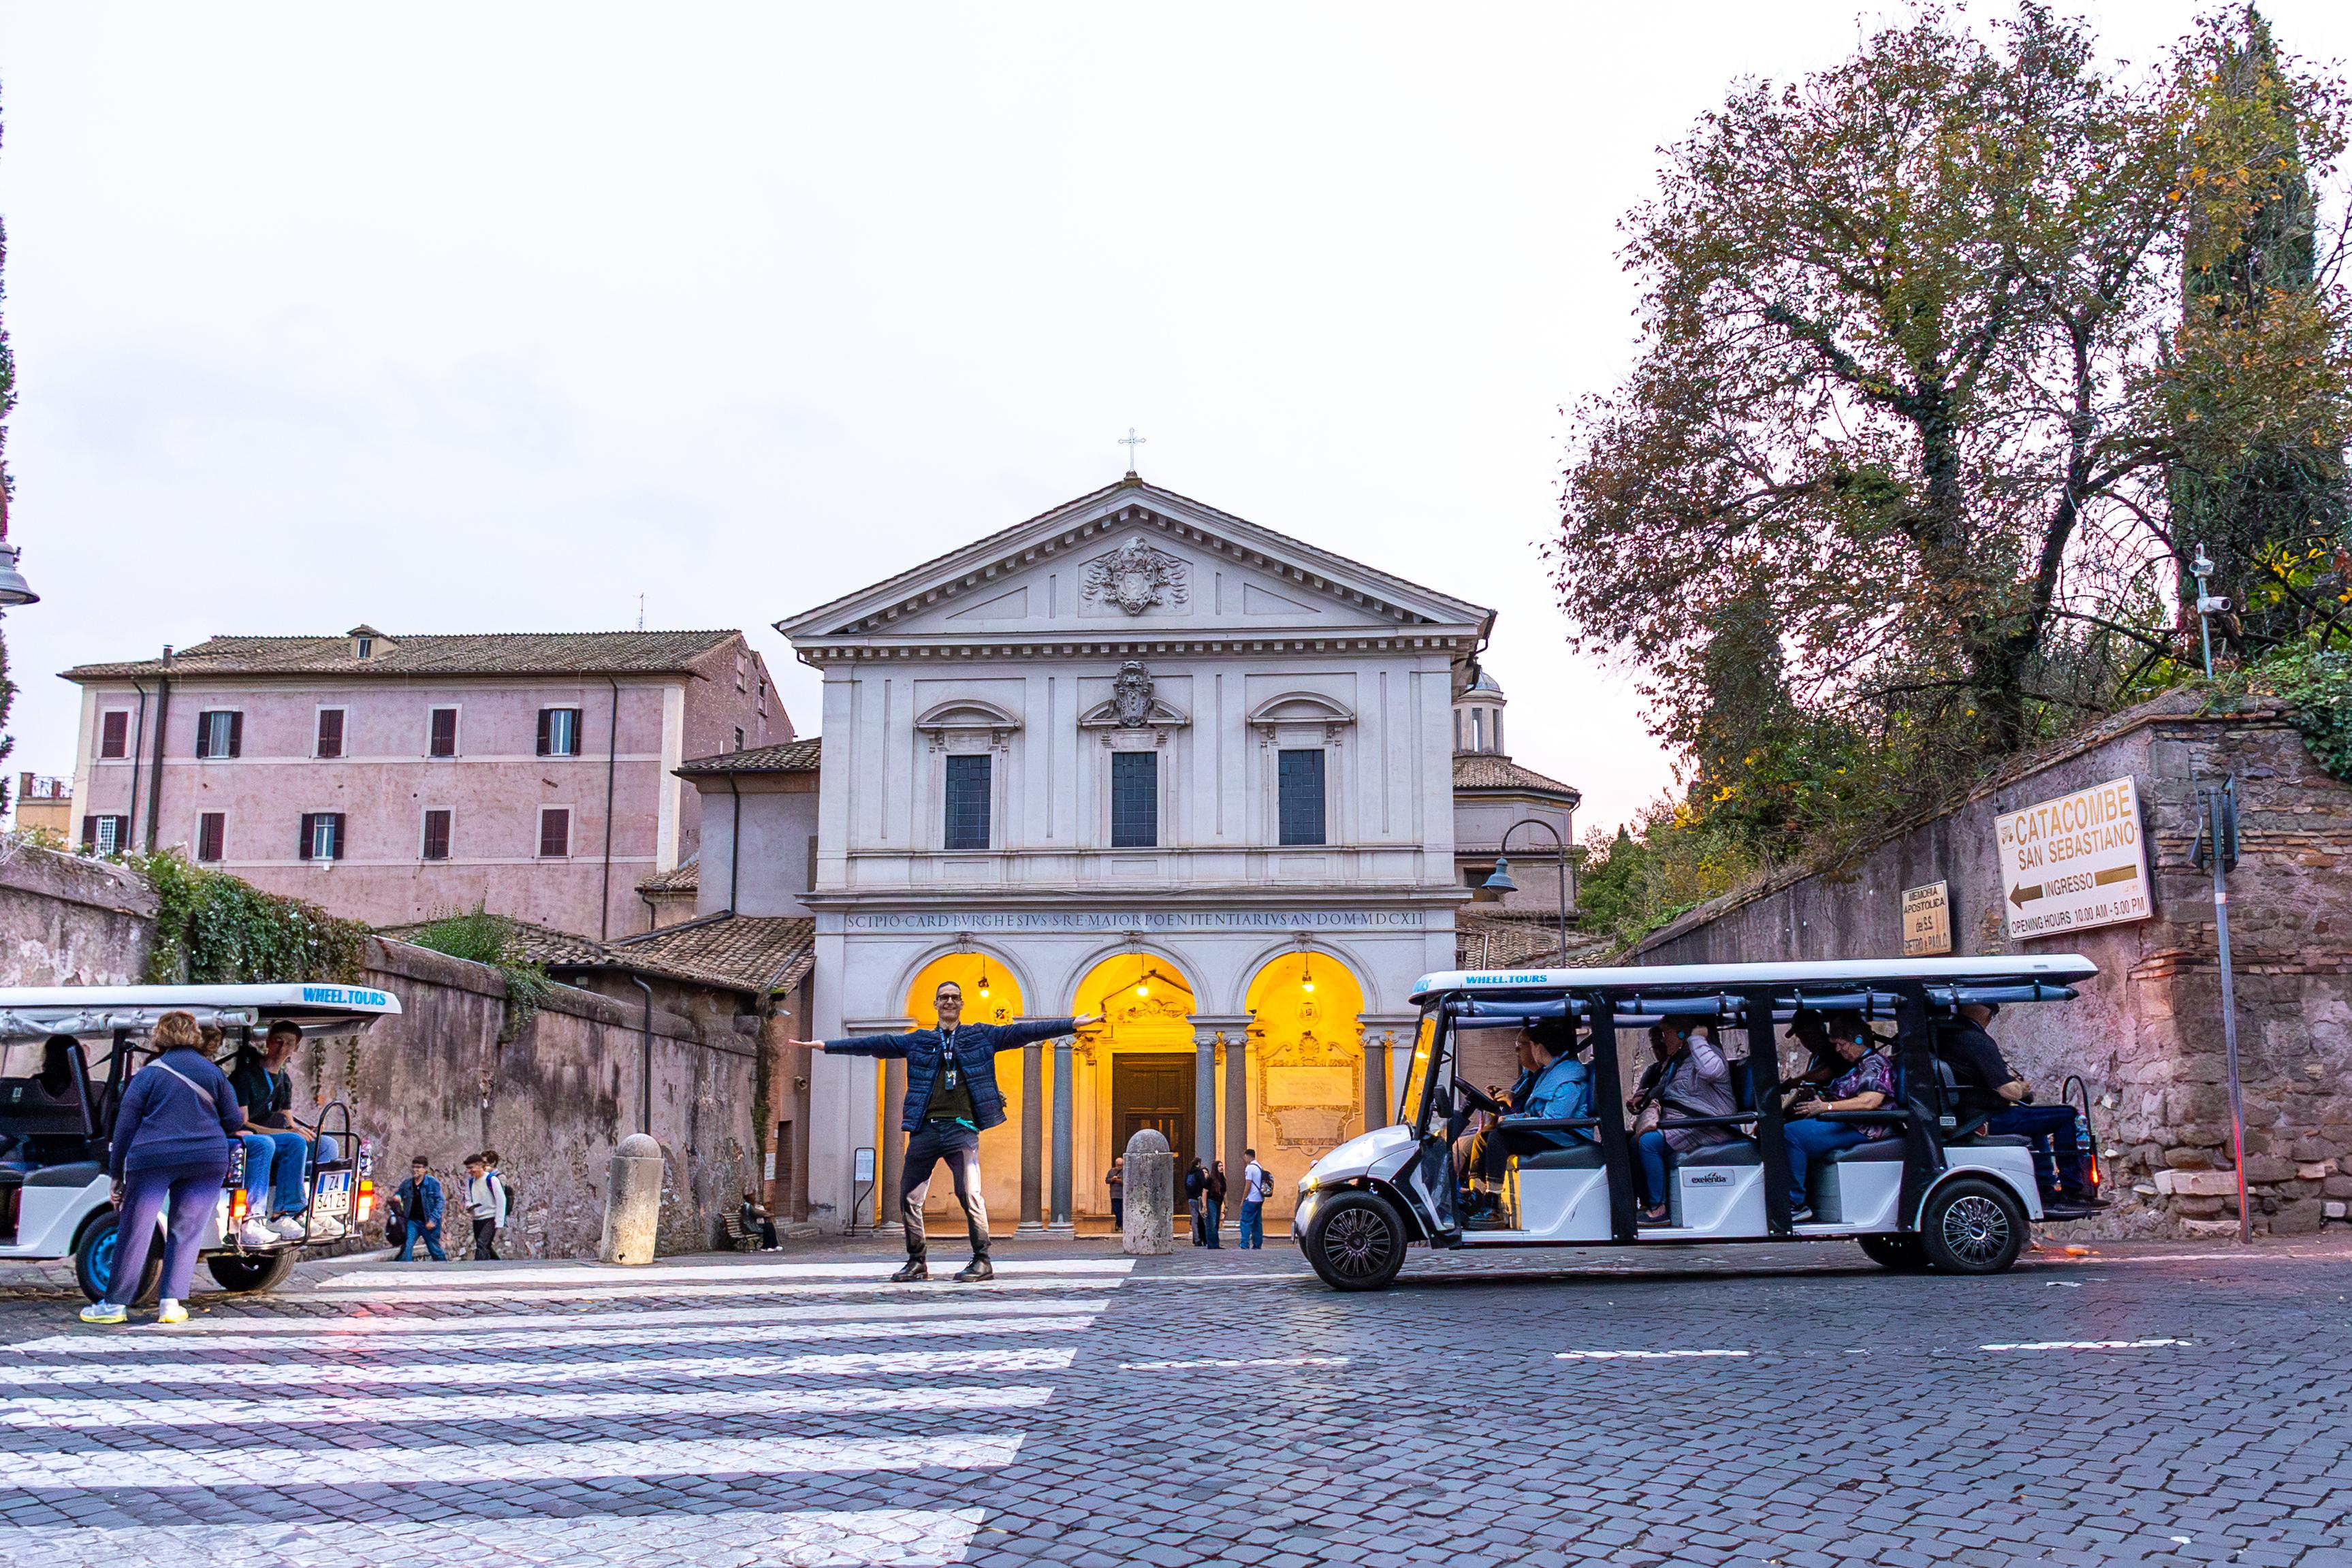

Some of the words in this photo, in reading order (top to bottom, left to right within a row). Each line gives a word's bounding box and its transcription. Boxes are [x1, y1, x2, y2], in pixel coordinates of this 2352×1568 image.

[2015, 784, 2132, 846] CATACOMBE
[2018, 845, 2044, 871] SAN
[2048, 820, 2135, 863] SEBASTIANO
[1909, 886, 1937, 901] MEMORIA
[2044, 872, 2093, 897] INGRESSO
[1903, 897, 1945, 914] APOSTOLICA
[2011, 916, 2044, 933] OPENING
[2045, 910, 2072, 928] HOURS
[2074, 906, 2093, 923] 10.00
[2095, 903, 2108, 918] AM
[2114, 901, 2130, 916] 5.00
[2132, 896, 2146, 913] PM
[847, 914, 900, 928] SCIPIO
[905, 914, 948, 927] CARD
[1090, 914, 1141, 926] MAIOR
[1145, 913, 1287, 926] POENITENTIARIVS
[1361, 912, 1423, 925] MDCXII
[1466, 974, 1547, 984] WHEEL.TOURS
[303, 987, 386, 1006] WHEEL.TOURS
[328, 1176, 339, 1191] ZA
